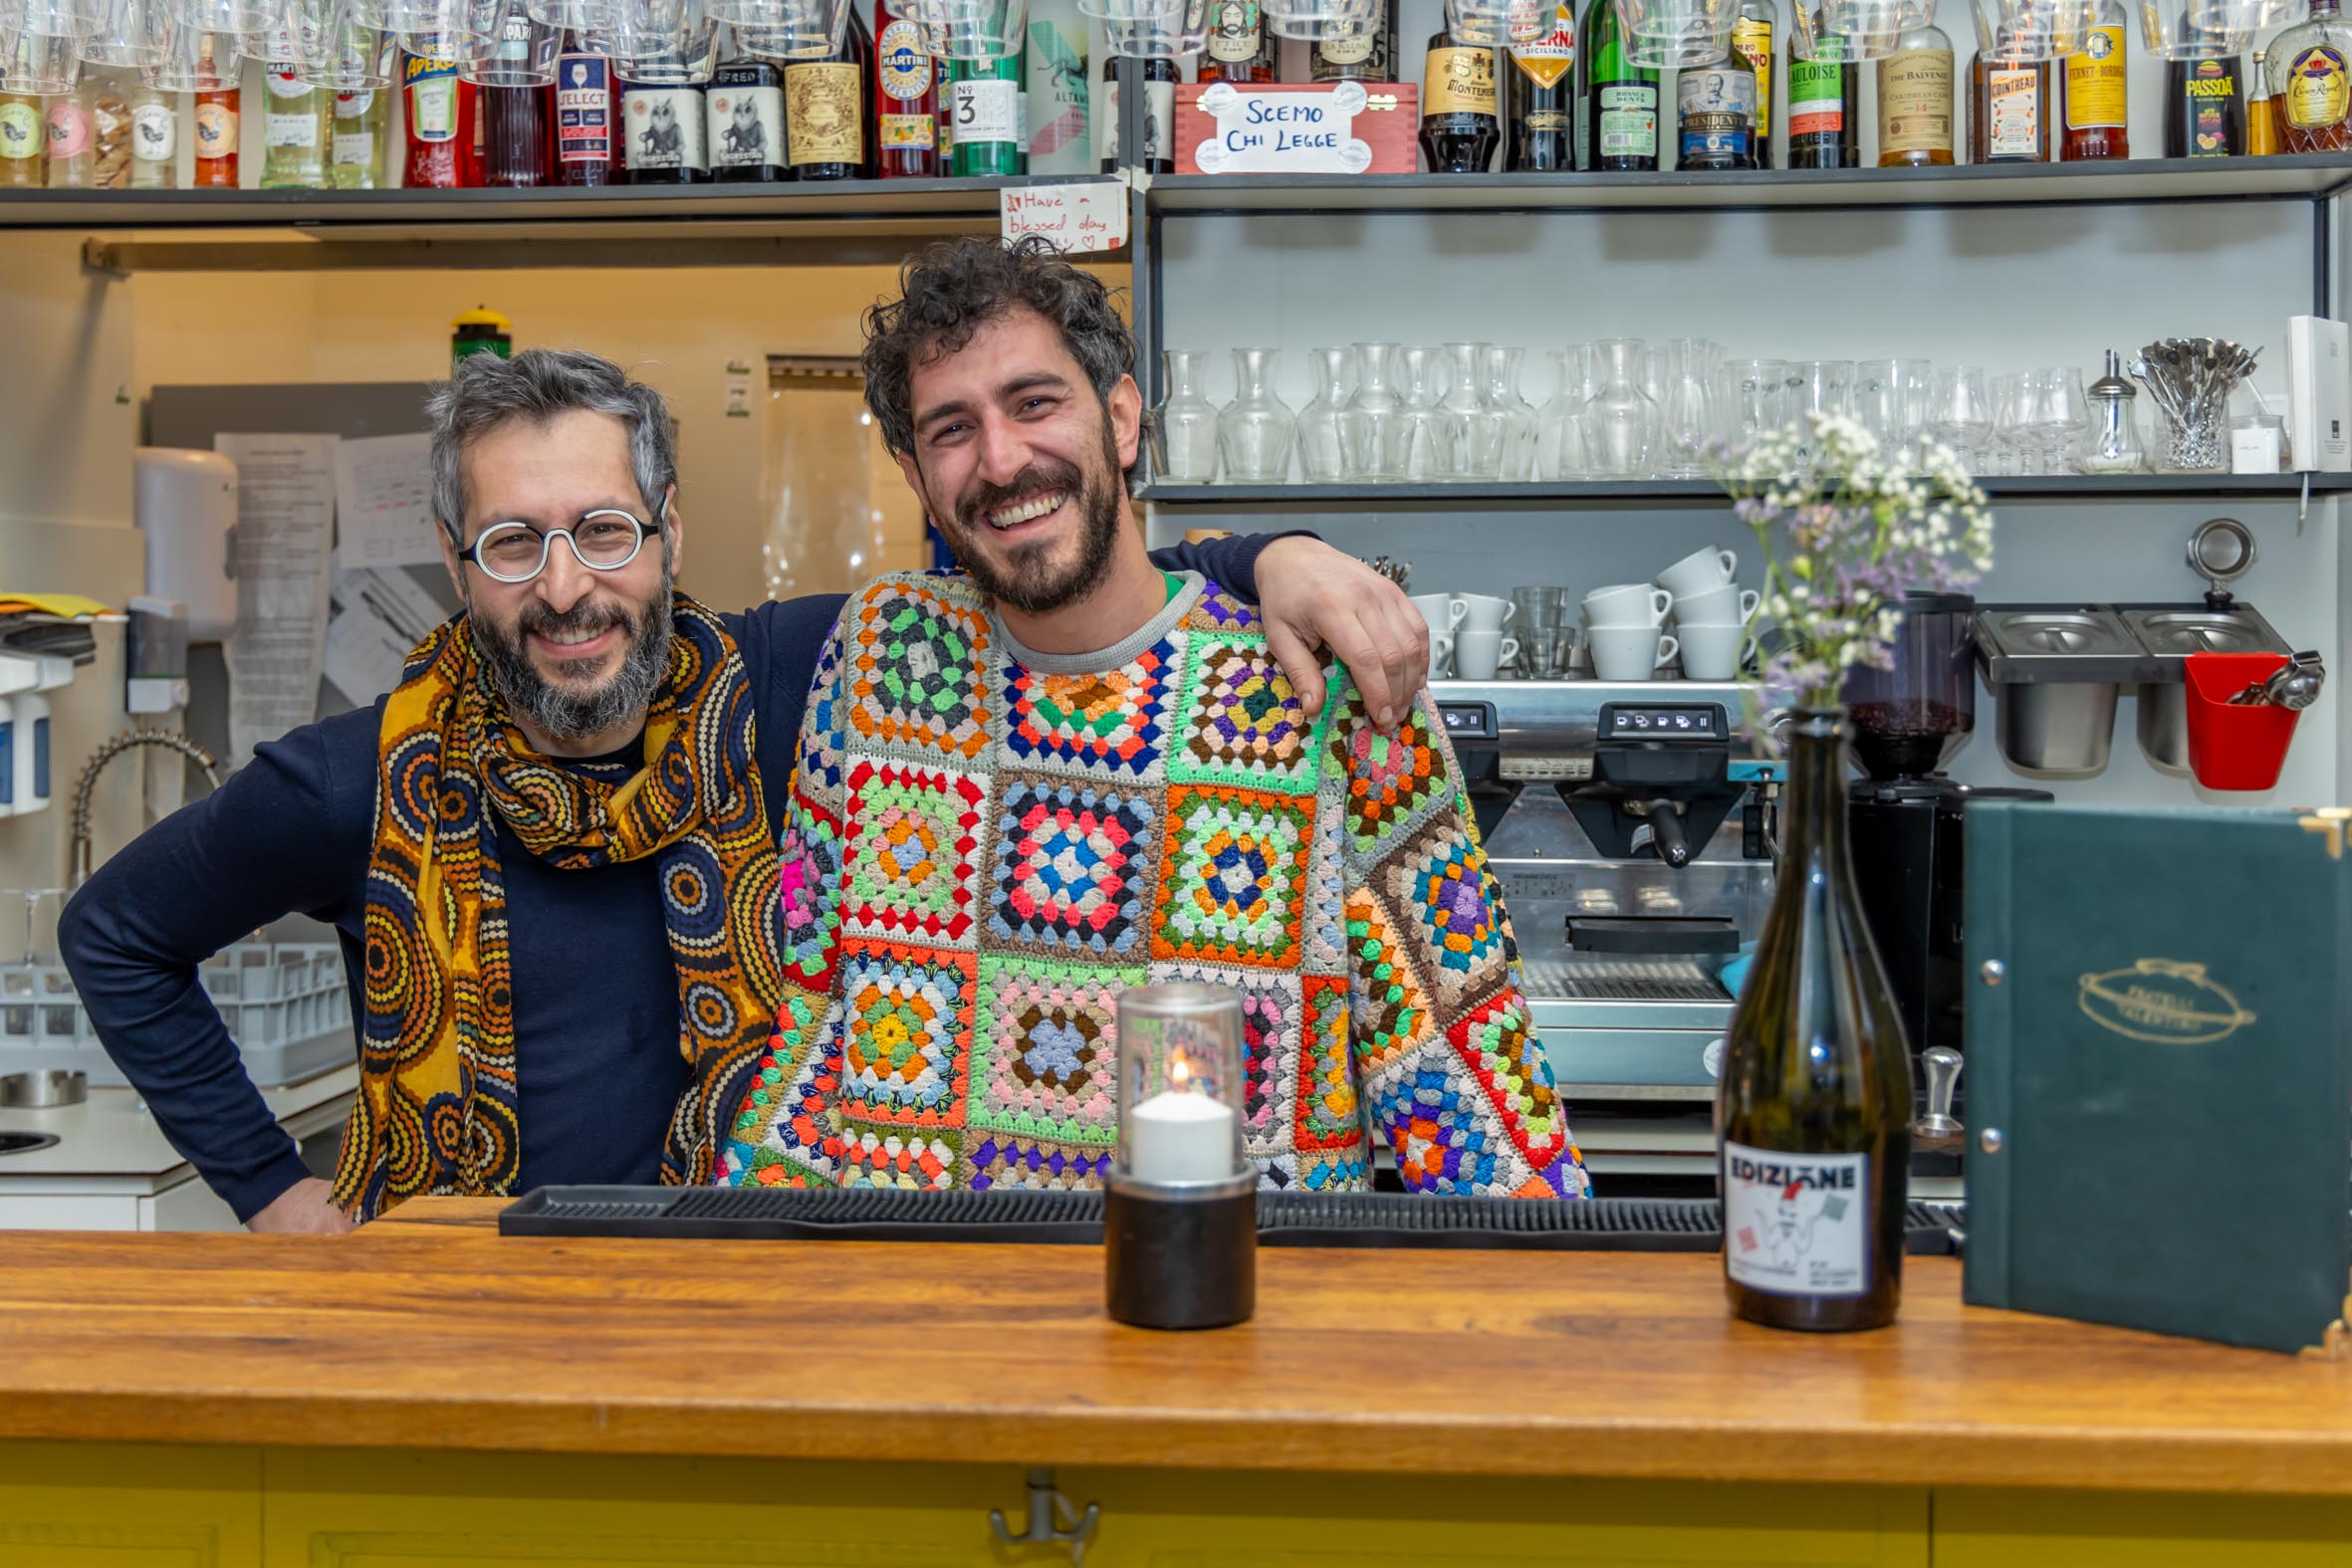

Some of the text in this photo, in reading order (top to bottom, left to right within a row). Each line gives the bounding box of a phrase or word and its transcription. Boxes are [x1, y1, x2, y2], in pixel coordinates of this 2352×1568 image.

[881, 54, 928, 68] MARTINI
[1991, 76, 2036, 98] COINTREAU
[561, 94, 606, 106] SELECT
[958, 96, 976, 124] 3
[1246, 100, 1323, 124] SCEMO
[1226, 129, 1337, 152] CHI LEGGE
[1024, 192, 1064, 208] Have
[1010, 213, 1066, 234] blessed
